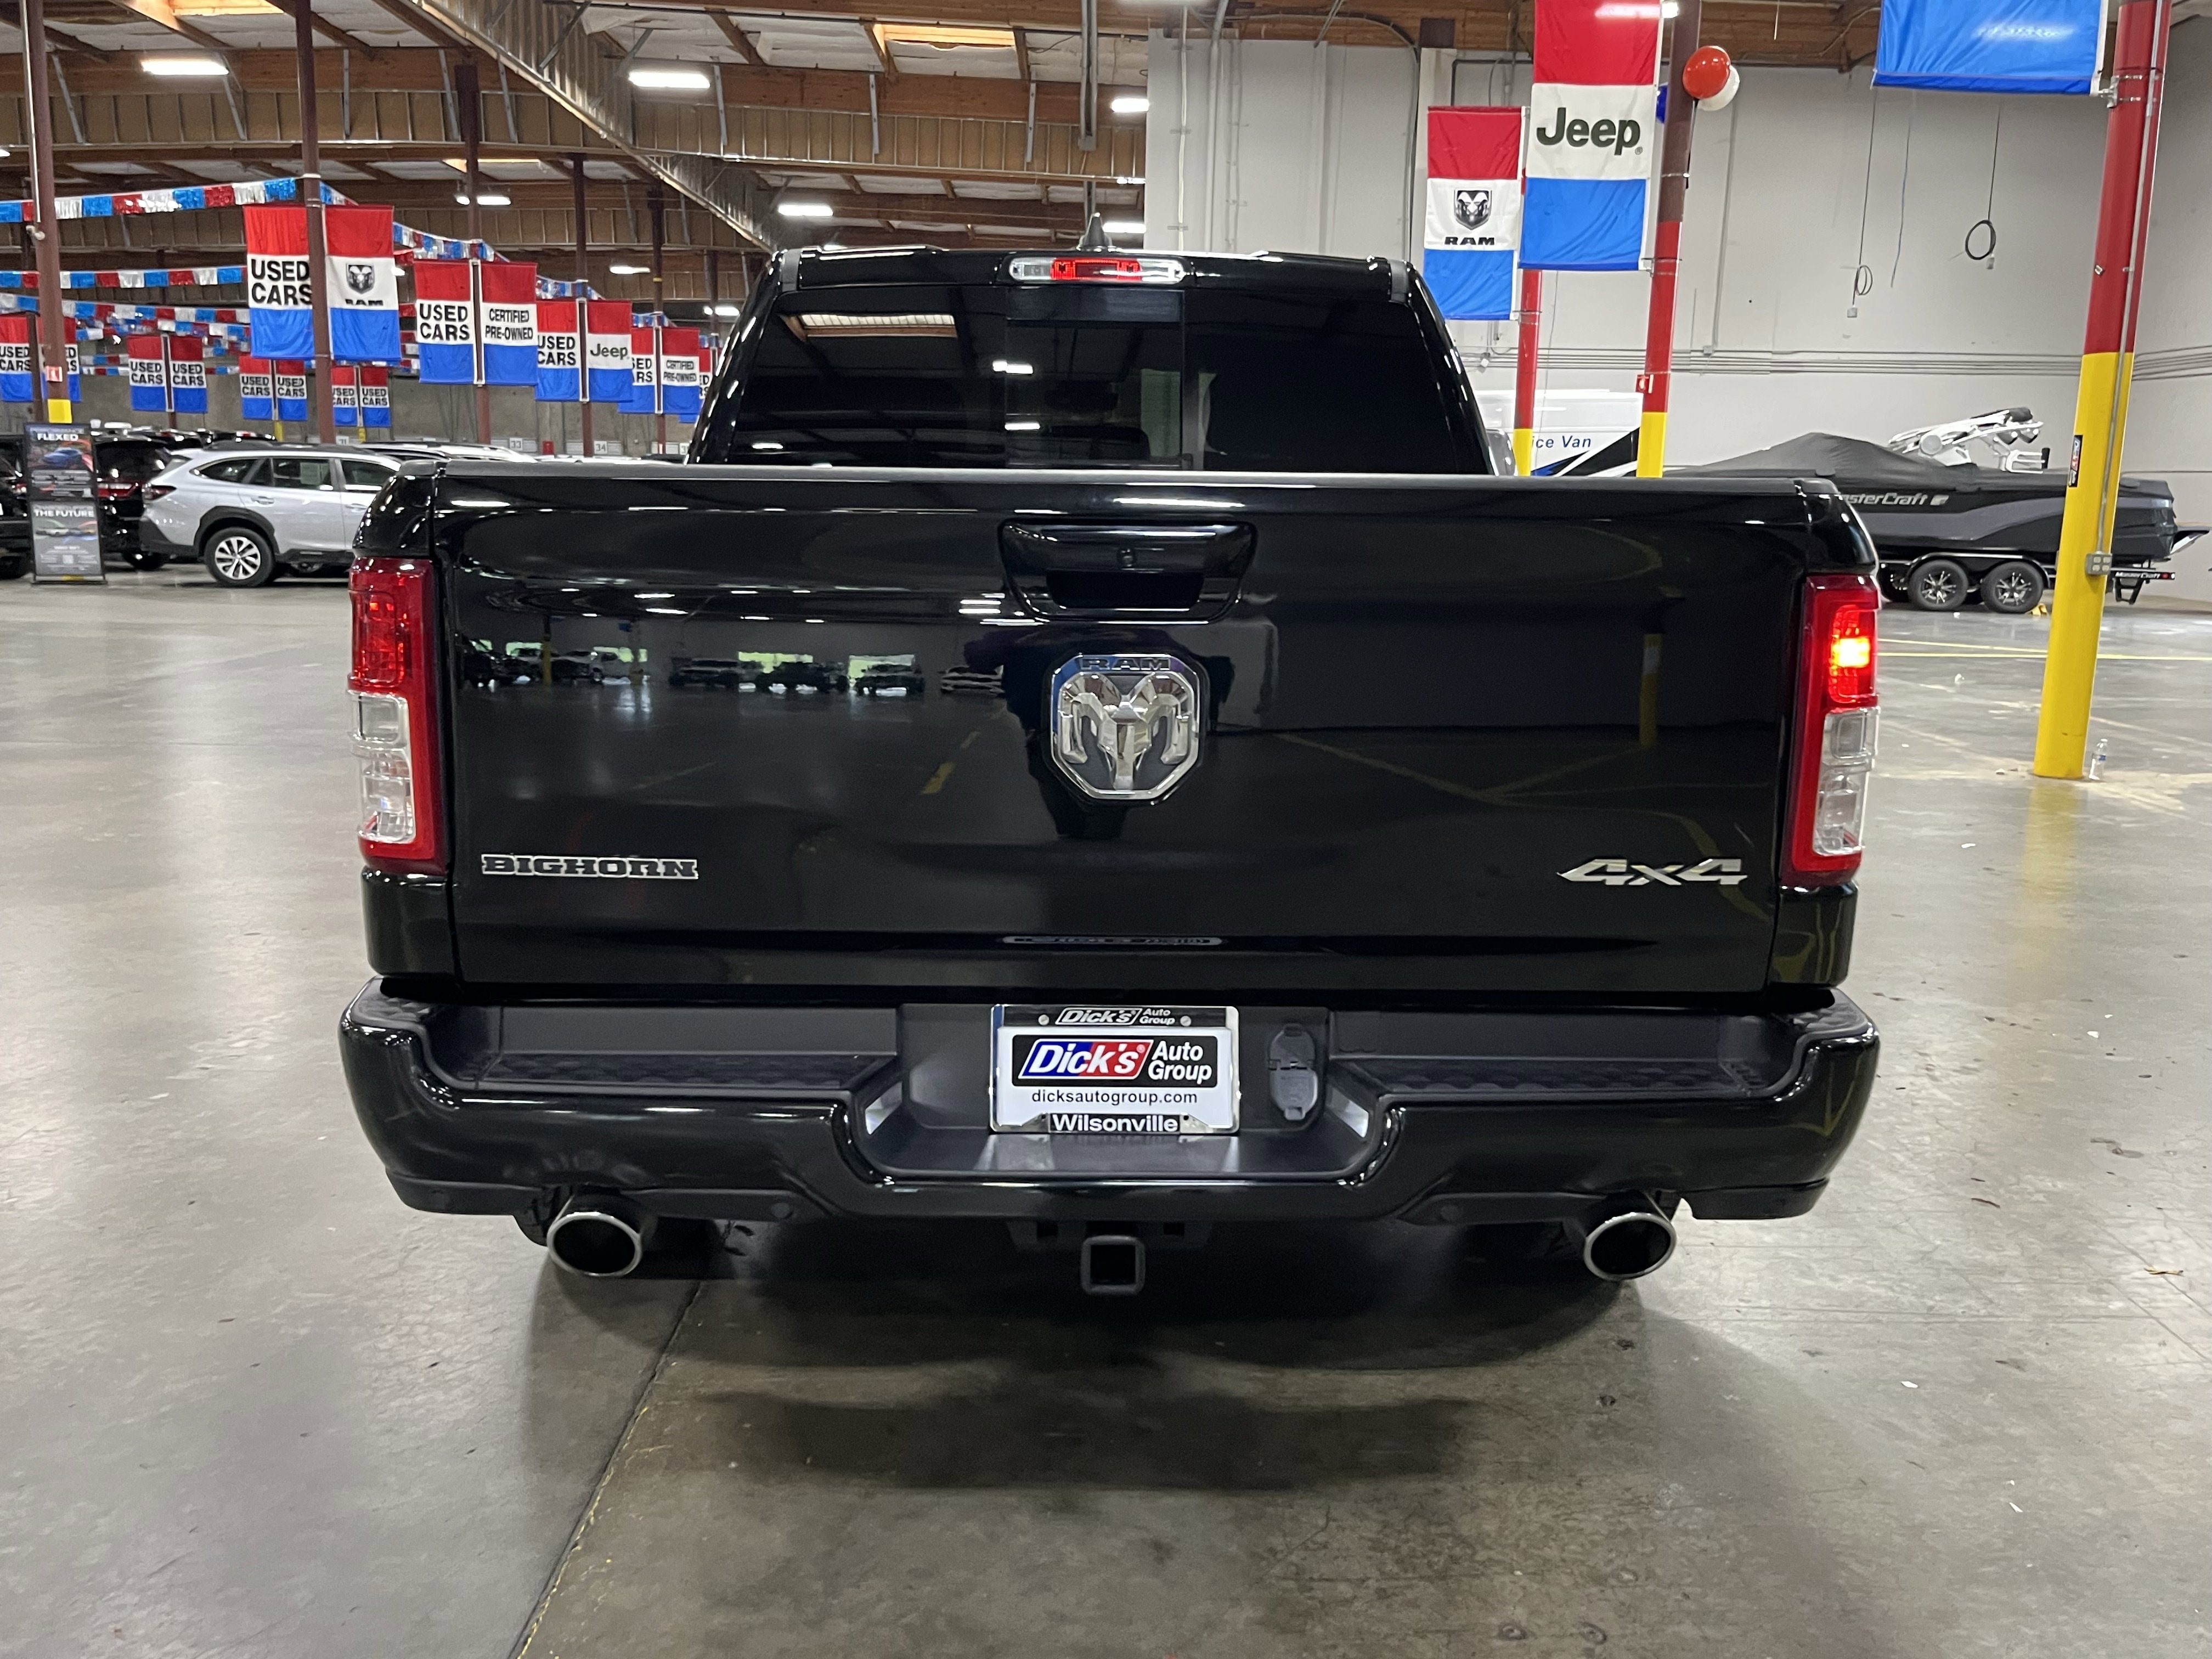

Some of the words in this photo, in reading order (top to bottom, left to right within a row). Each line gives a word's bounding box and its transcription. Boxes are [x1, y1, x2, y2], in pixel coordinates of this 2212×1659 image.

[1537, 108, 1640, 155] Jeep
[1444, 237, 1495, 245] RAM
[251, 259, 309, 281] USED
[252, 283, 312, 306] CARS
[420, 303, 468, 322] USED
[489, 308, 529, 323] CERTIFIED
[420, 323, 470, 341] CARS
[485, 325, 533, 340] PRE-OWNED
[538, 335, 575, 350] USED
[0, 346, 30, 358] USED
[590, 343, 628, 360] Jeep
[538, 351, 577, 366] CARS
[632, 358, 652, 370] ED
[0, 359, 31, 371] CARS
[131, 361, 162, 373] USED
[173, 363, 203, 374] USED
[666, 360, 694, 370] CERTIFIED
[131, 373, 163, 385] CARS
[173, 375, 205, 386] CARS
[242, 376, 269, 385] USED
[278, 377, 304, 387] USED
[633, 371, 653, 383] RS
[663, 372, 697, 382] PRE-OWNED
[242, 386, 270, 396] CARS
[278, 387, 305, 397] CARS
[363, 397, 388, 406] CARS
[1562, 435, 1591, 448] Van
[1841, 493, 1928, 505] asterCraft
[1081, 657, 1171, 670] RAM
[481, 854, 698, 879] BIGHORN
[1062, 1009, 1132, 1023] Dick's
[1139, 1016, 1176, 1025] Group
[1029, 1043, 1139, 1074] Dick's
[1151, 1040, 1204, 1061] Auto
[1148, 1060, 1212, 1084] Group
[1032, 1090, 1197, 1106] dicksautogroup.com
[1053, 1114, 1178, 1132] Wilsonville
